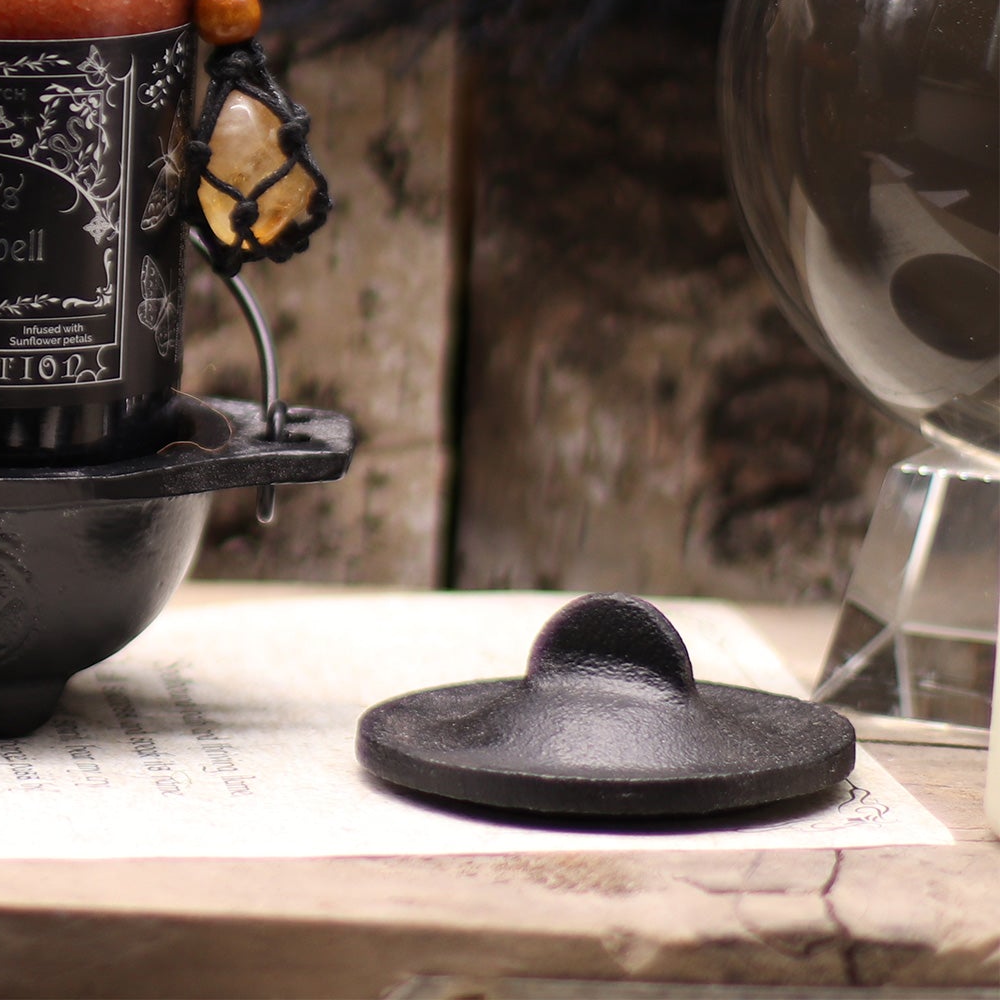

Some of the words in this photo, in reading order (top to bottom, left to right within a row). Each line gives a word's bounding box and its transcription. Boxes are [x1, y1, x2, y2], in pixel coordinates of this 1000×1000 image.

[22, 323, 61, 336] Infused
[62, 322, 84, 334] with
[9, 335, 61, 347] Sunflower
[62, 333, 93, 347] petals
